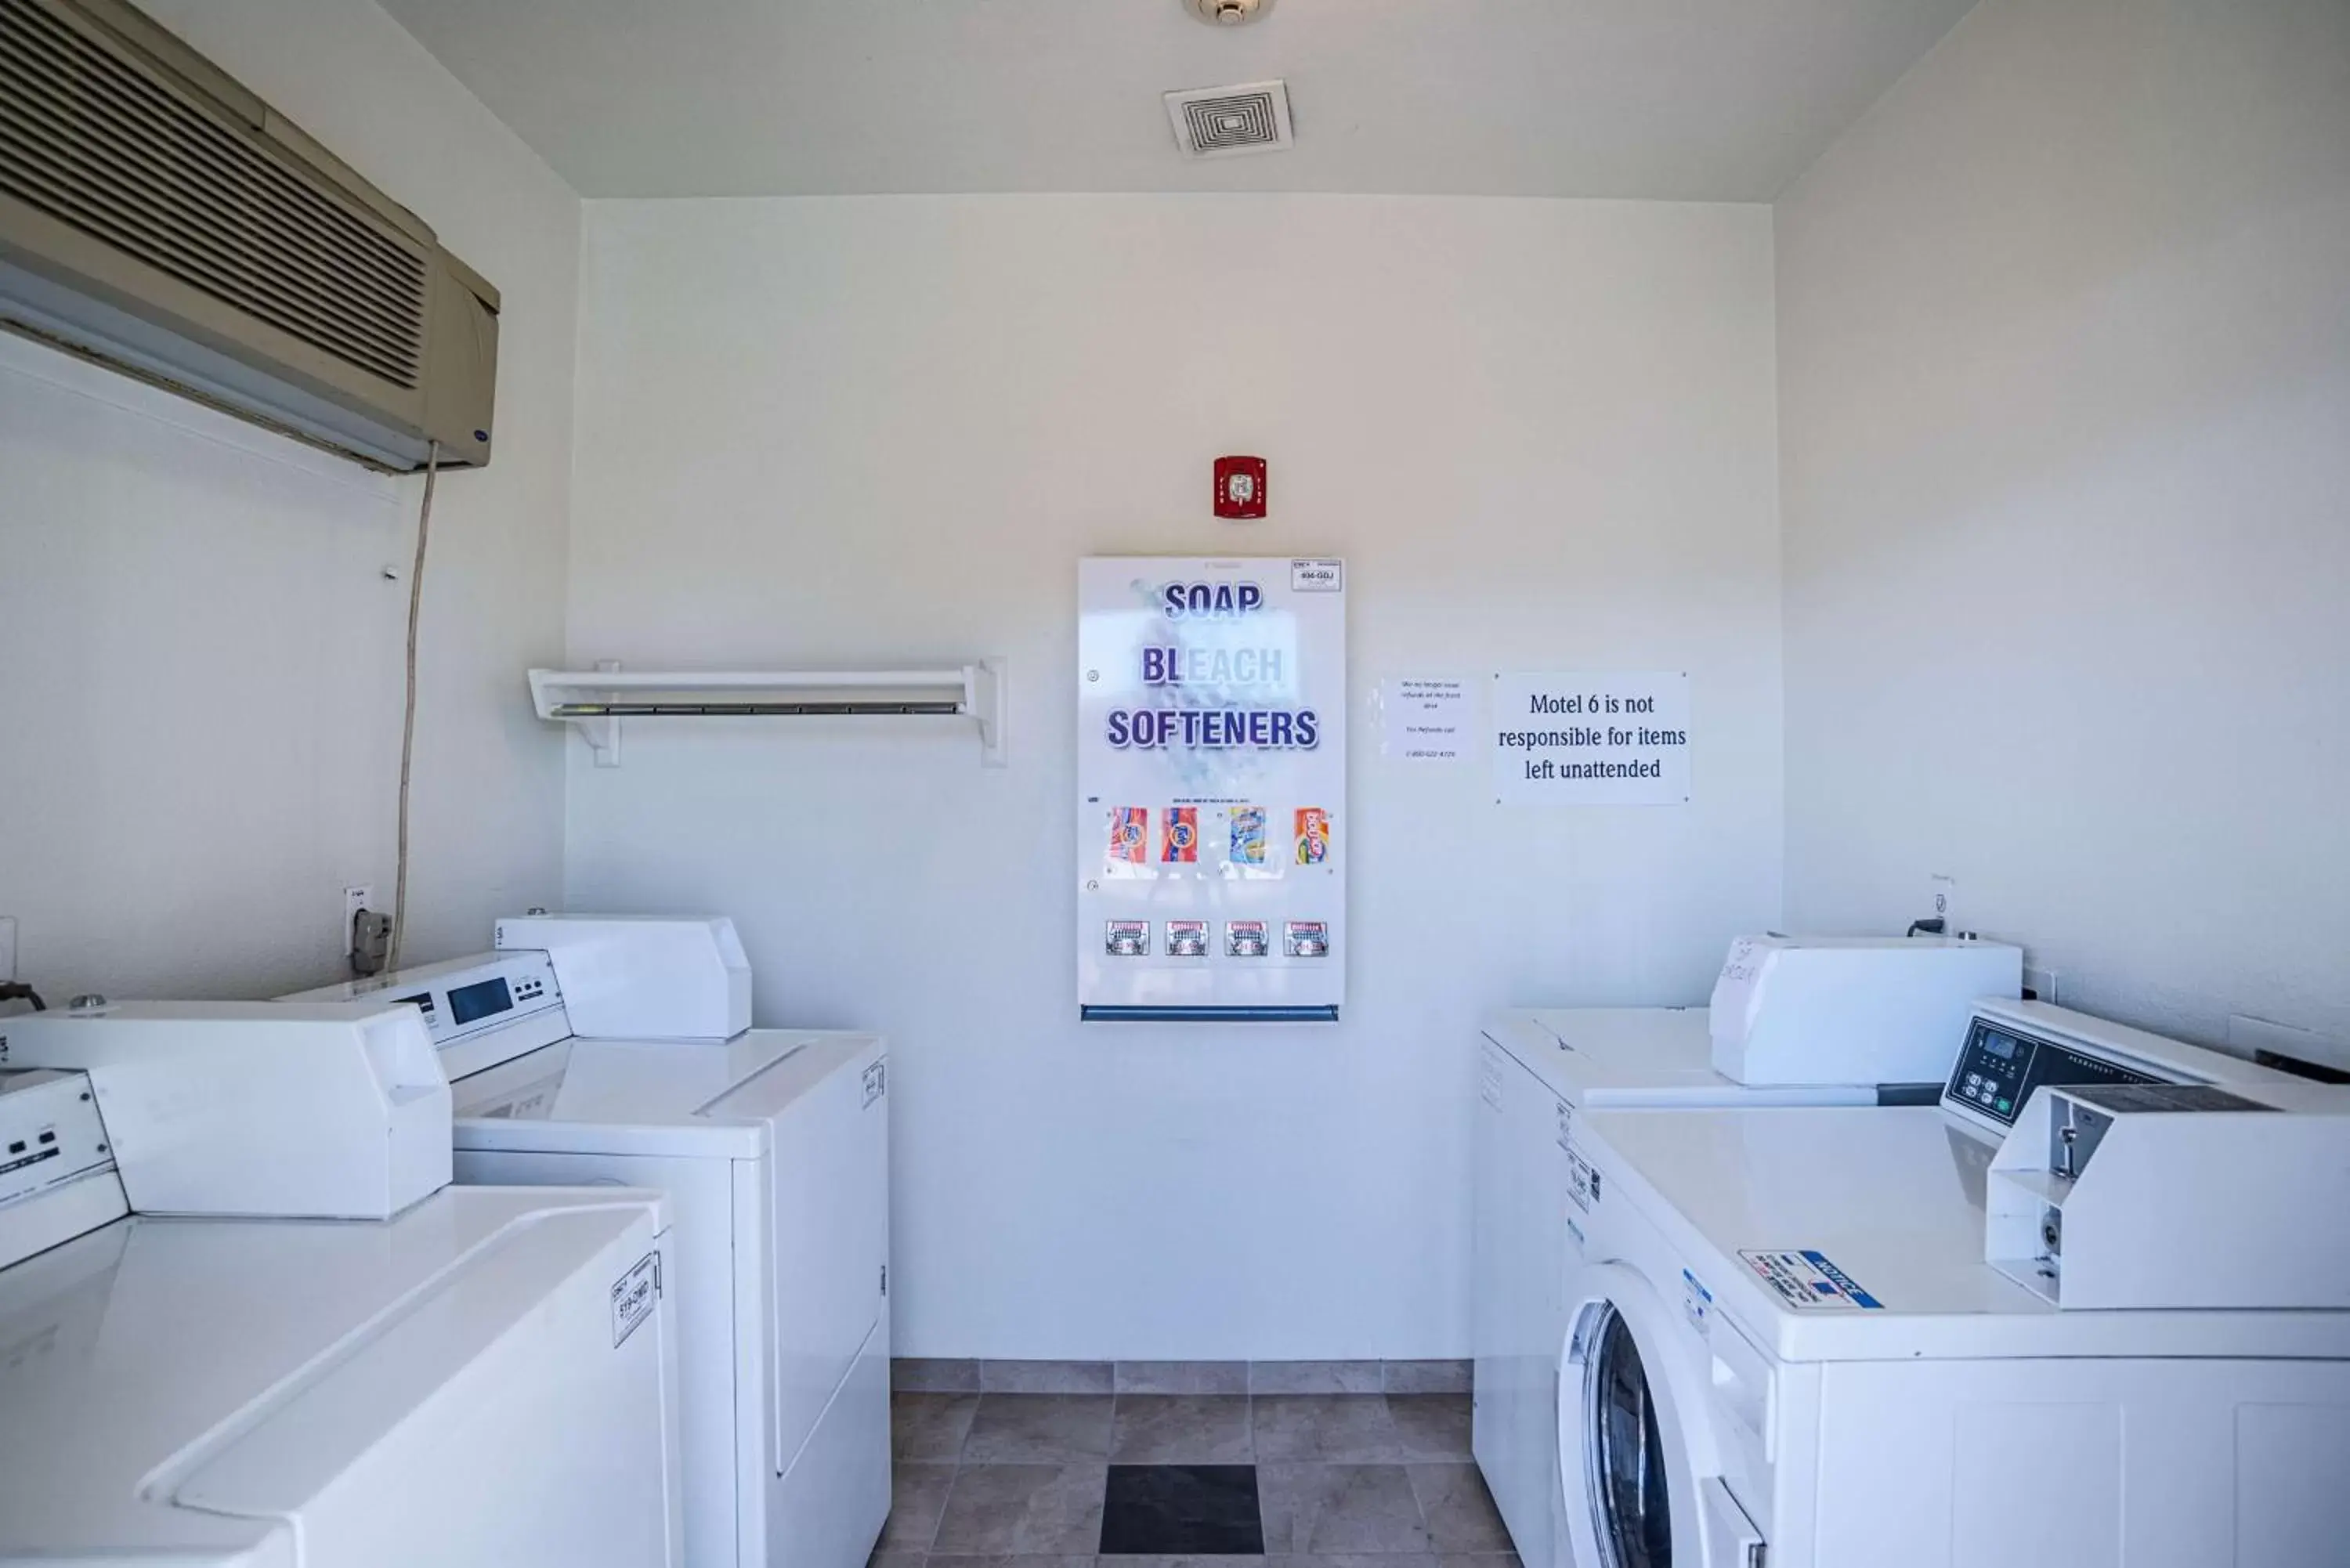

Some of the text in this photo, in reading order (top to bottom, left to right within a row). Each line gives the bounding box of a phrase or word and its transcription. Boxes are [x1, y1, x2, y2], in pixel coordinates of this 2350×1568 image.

[1164, 583, 1261, 619] SOAP
[1143, 648, 1282, 681] BLEACH
[1530, 694, 1655, 714] Motel 6 is not
[1108, 710, 1317, 745] SOFTENERS
[1499, 726, 1687, 752] responsible for items
[1525, 758, 1661, 779] left unattended
